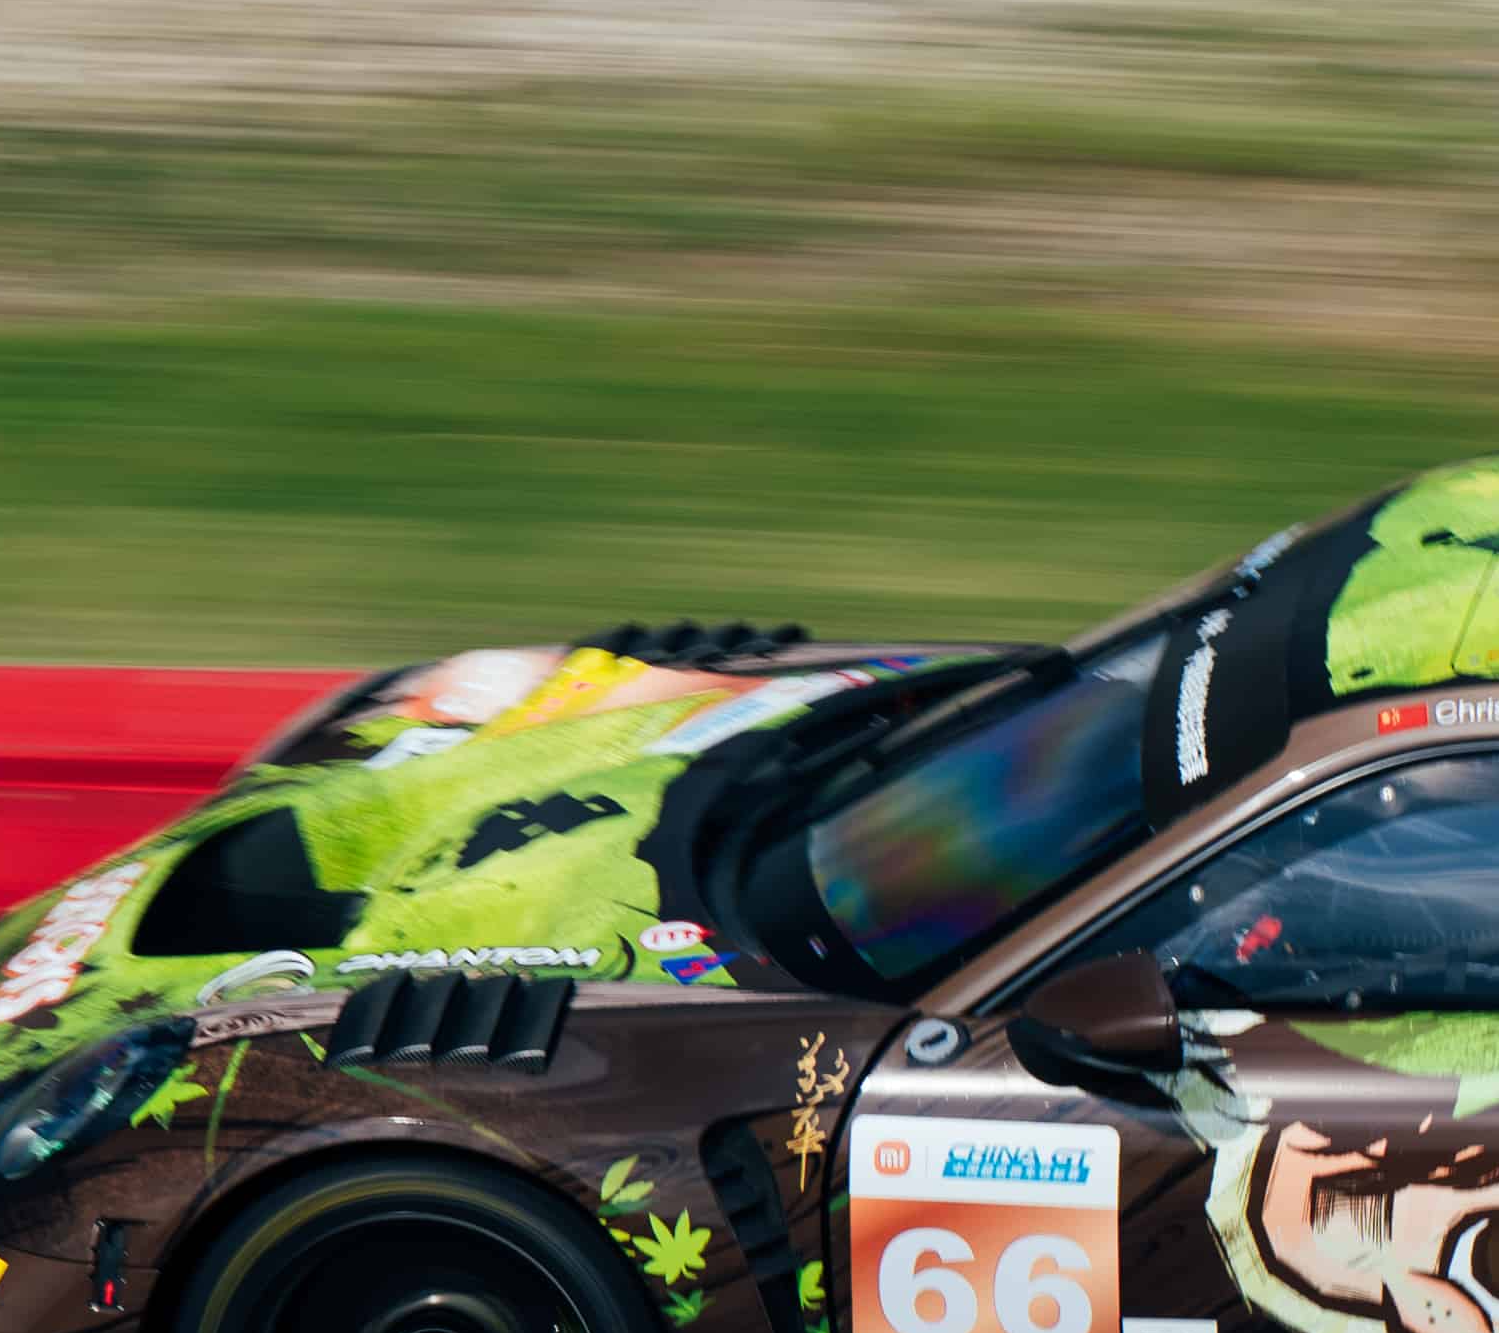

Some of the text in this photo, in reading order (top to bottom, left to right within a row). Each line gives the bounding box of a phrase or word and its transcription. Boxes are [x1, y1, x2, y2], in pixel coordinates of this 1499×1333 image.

[337, 947, 602, 973] PHANTOM
[946, 1143, 1095, 1170] CHINA GT
